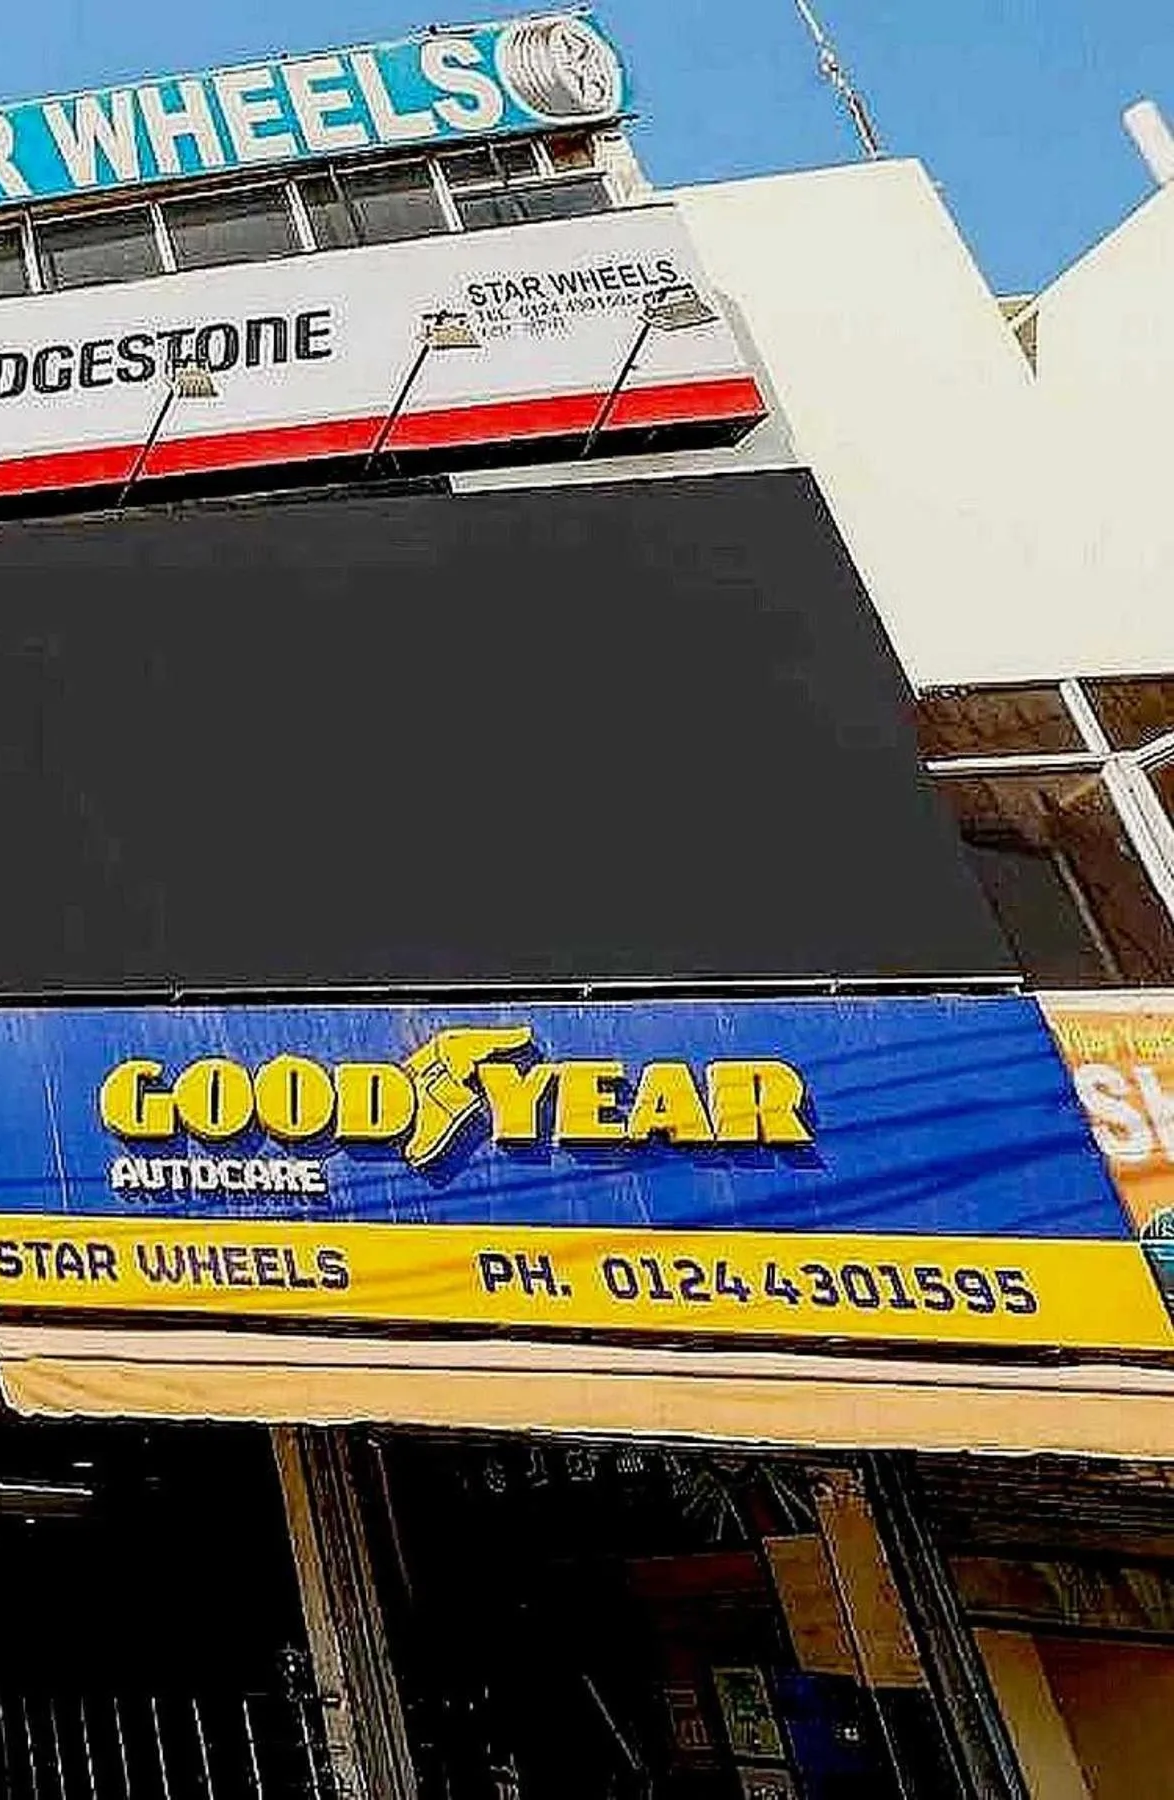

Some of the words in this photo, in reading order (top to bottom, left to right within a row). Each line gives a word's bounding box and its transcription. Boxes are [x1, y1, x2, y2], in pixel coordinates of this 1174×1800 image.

[45, 38, 506, 187] WHEELS
[468, 276, 545, 306] STAR
[548, 259, 679, 296] WHEELS
[99, 1050, 816, 1152] GOODYEAR
[110, 1156, 328, 1195] AUTOCARE
[138, 1246, 351, 1291] WHEELS
[478, 1252, 572, 1297] PH.
